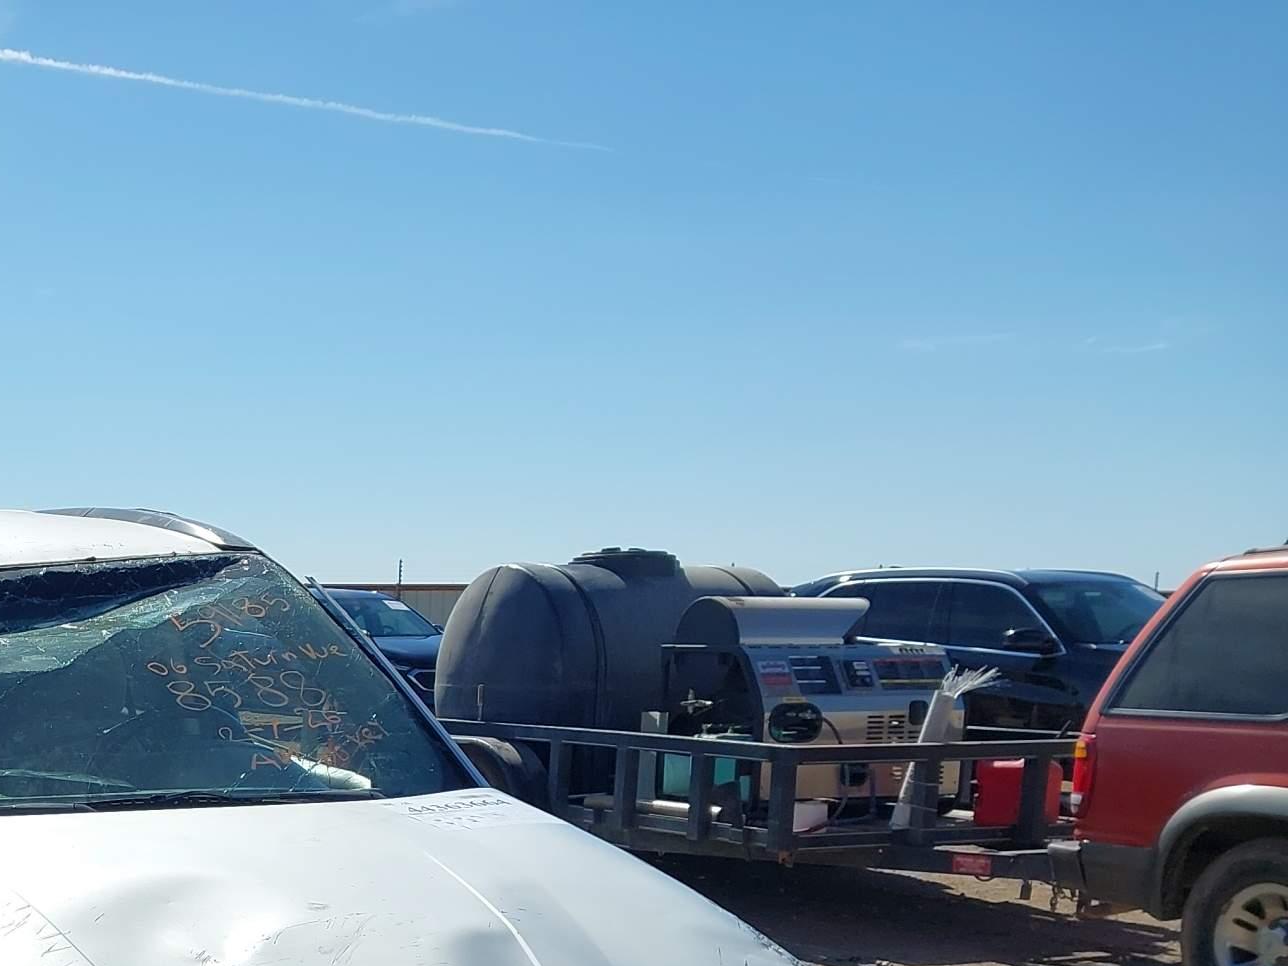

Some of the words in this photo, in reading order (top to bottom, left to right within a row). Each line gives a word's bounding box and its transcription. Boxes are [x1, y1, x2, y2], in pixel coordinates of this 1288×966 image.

[147, 657, 187, 677] 06
[166, 670, 327, 711] 8588
[407, 799, 513, 815] 44363664
